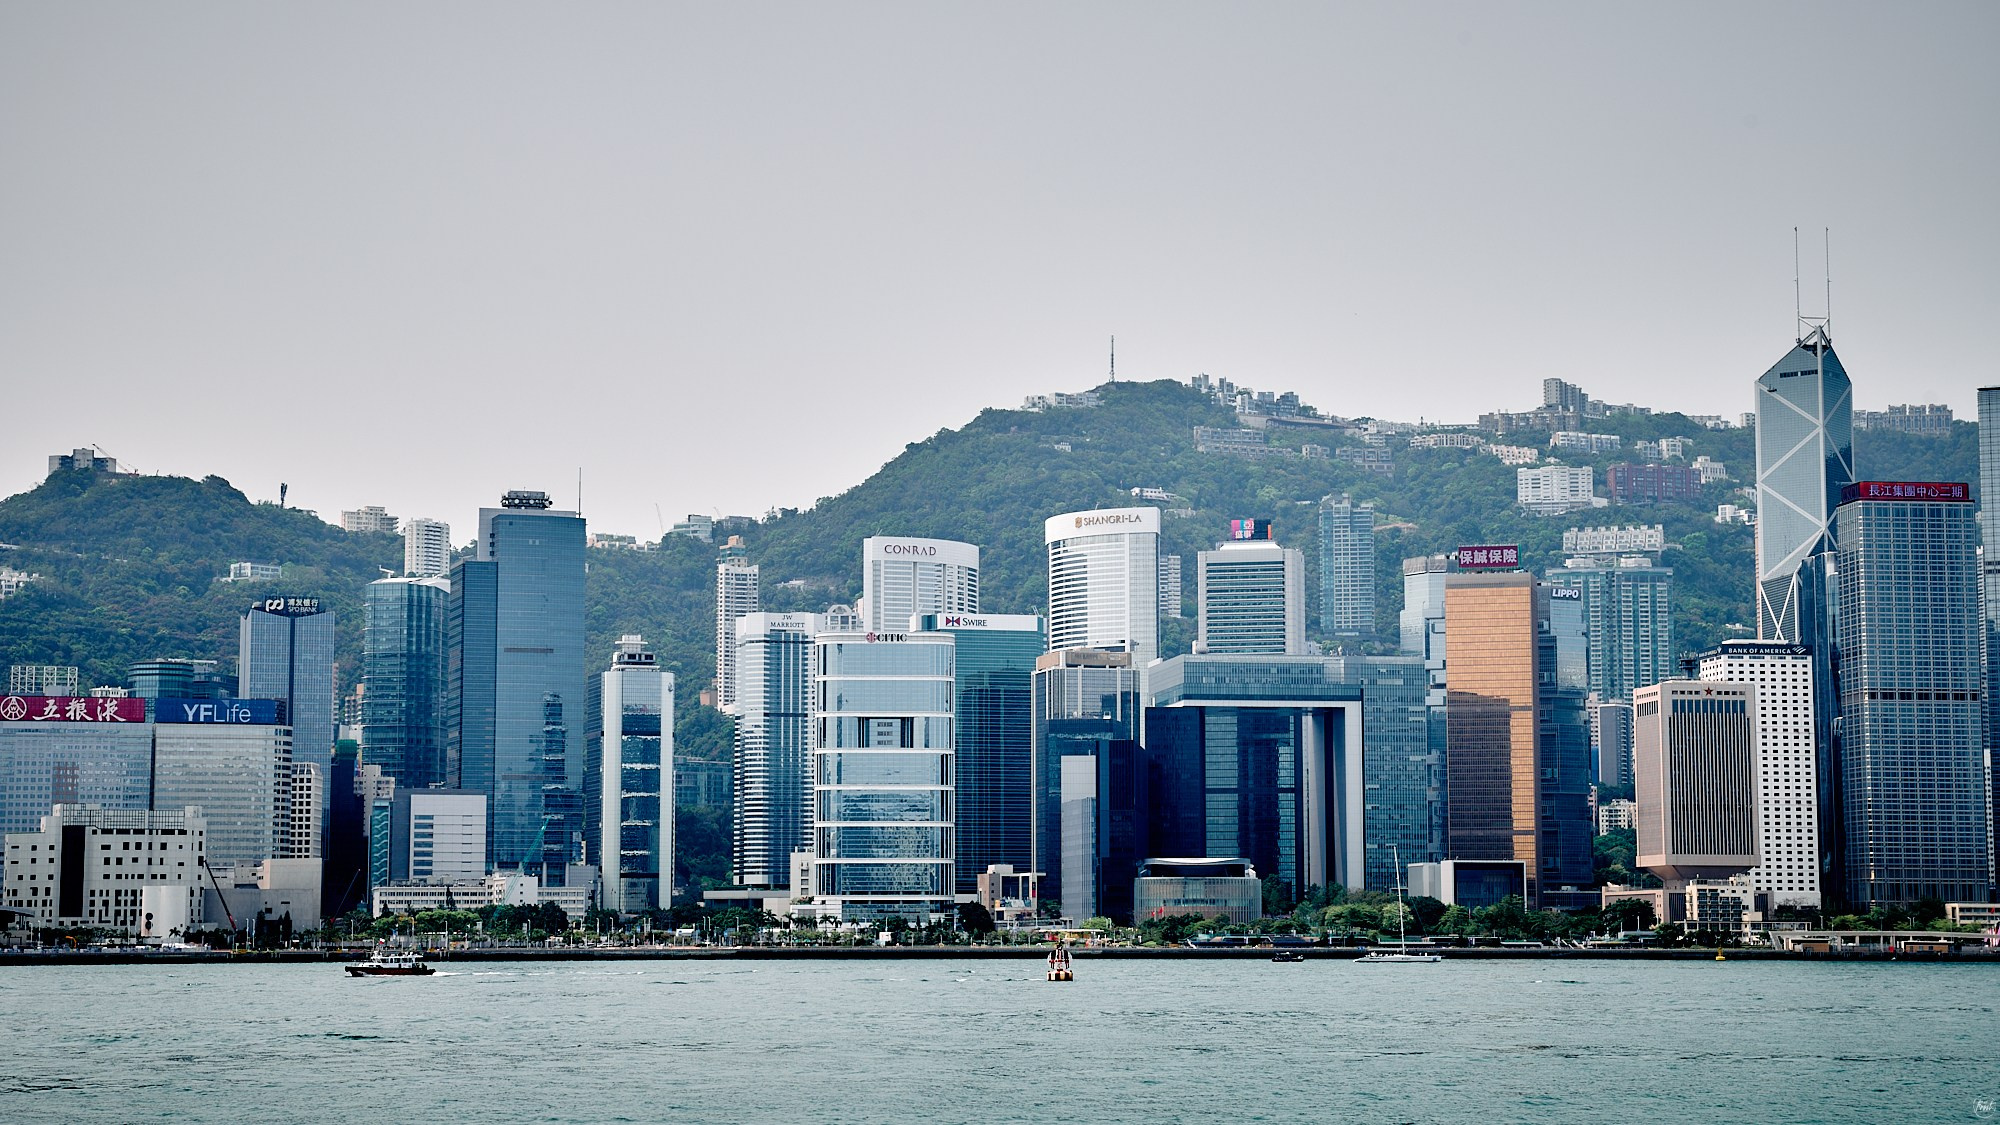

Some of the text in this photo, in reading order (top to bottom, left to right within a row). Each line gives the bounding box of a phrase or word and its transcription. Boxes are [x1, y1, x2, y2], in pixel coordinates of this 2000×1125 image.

[1869, 484, 1963, 497] 長江集團中心二期
[1083, 514, 1142, 526] SHANGRI-LA
[884, 544, 937, 556] CONRAD
[1459, 549, 1518, 565] 保誠保險
[1552, 588, 1579, 599] LIPPO
[877, 633, 908, 642] CITIC
[32, 697, 127, 722] 五粮液
[182, 703, 252, 723] YFLife
